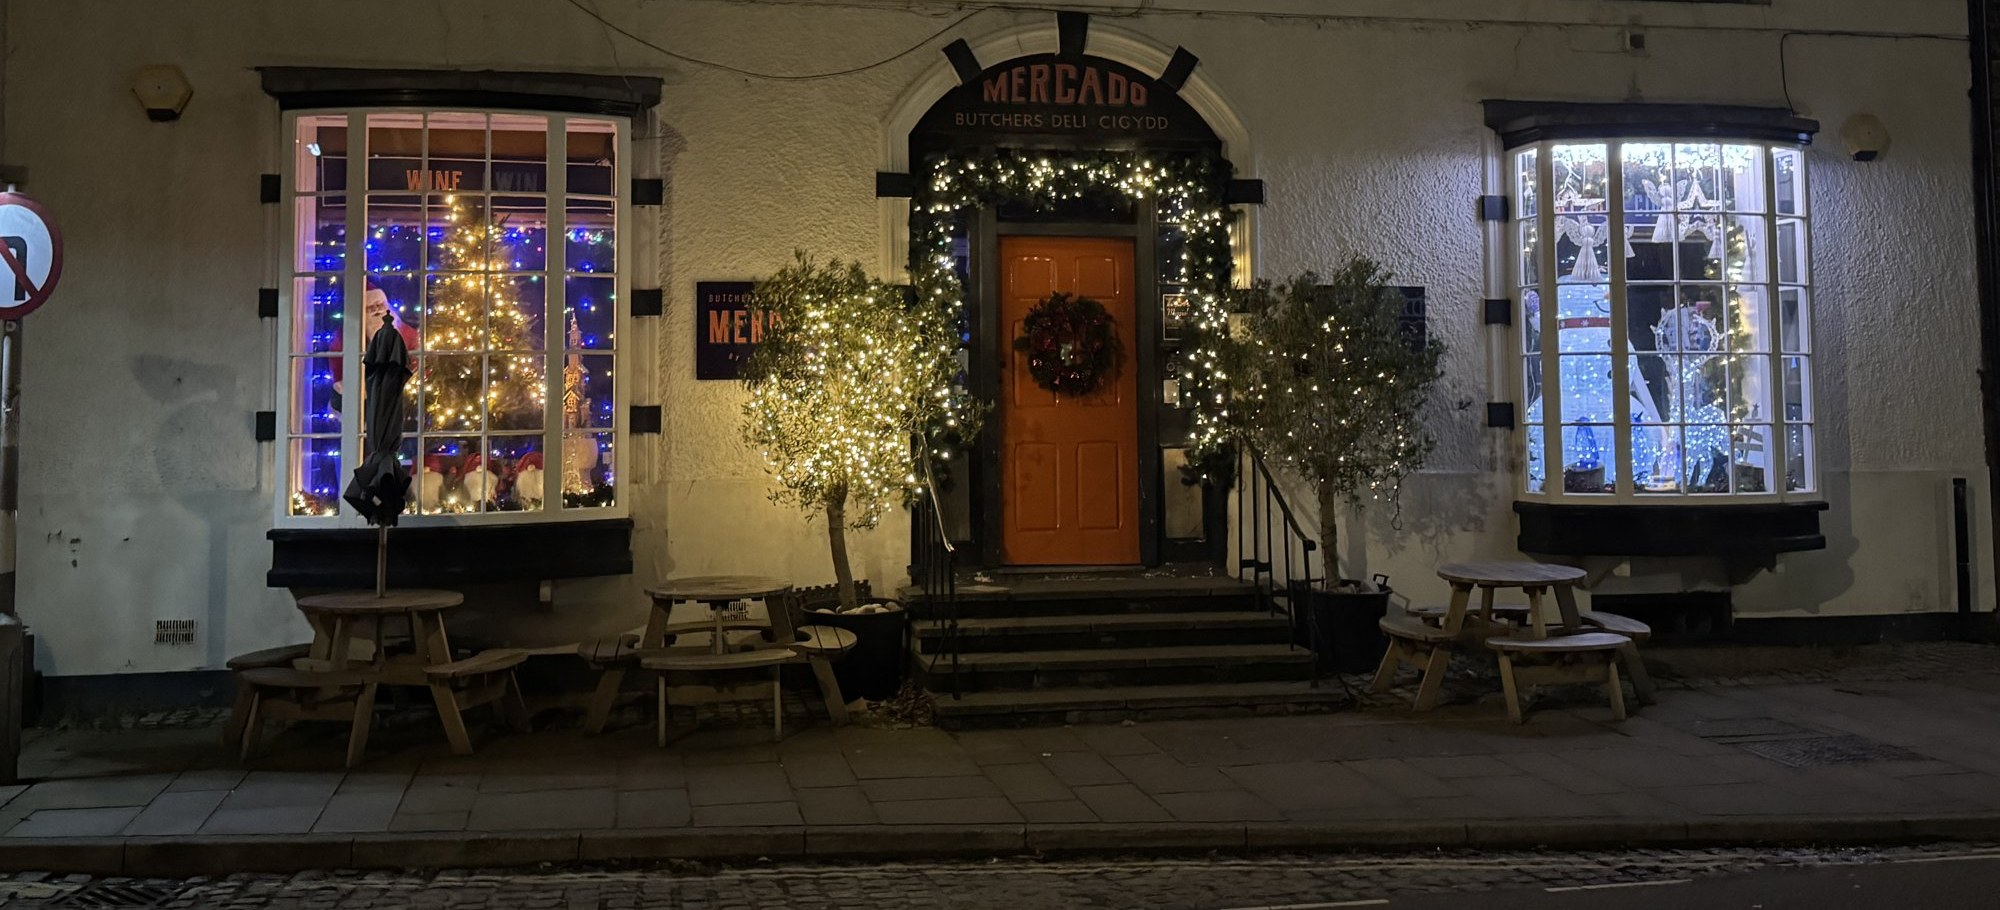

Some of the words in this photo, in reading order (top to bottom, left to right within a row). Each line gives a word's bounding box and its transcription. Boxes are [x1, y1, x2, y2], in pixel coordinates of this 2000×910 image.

[983, 64, 1147, 105] MERCADO
[955, 112, 1043, 127] BUTCHERS
[1051, 113, 1087, 128] DELI
[1099, 114, 1168, 130] CIGYDD
[482, 170, 538, 192] WIN
